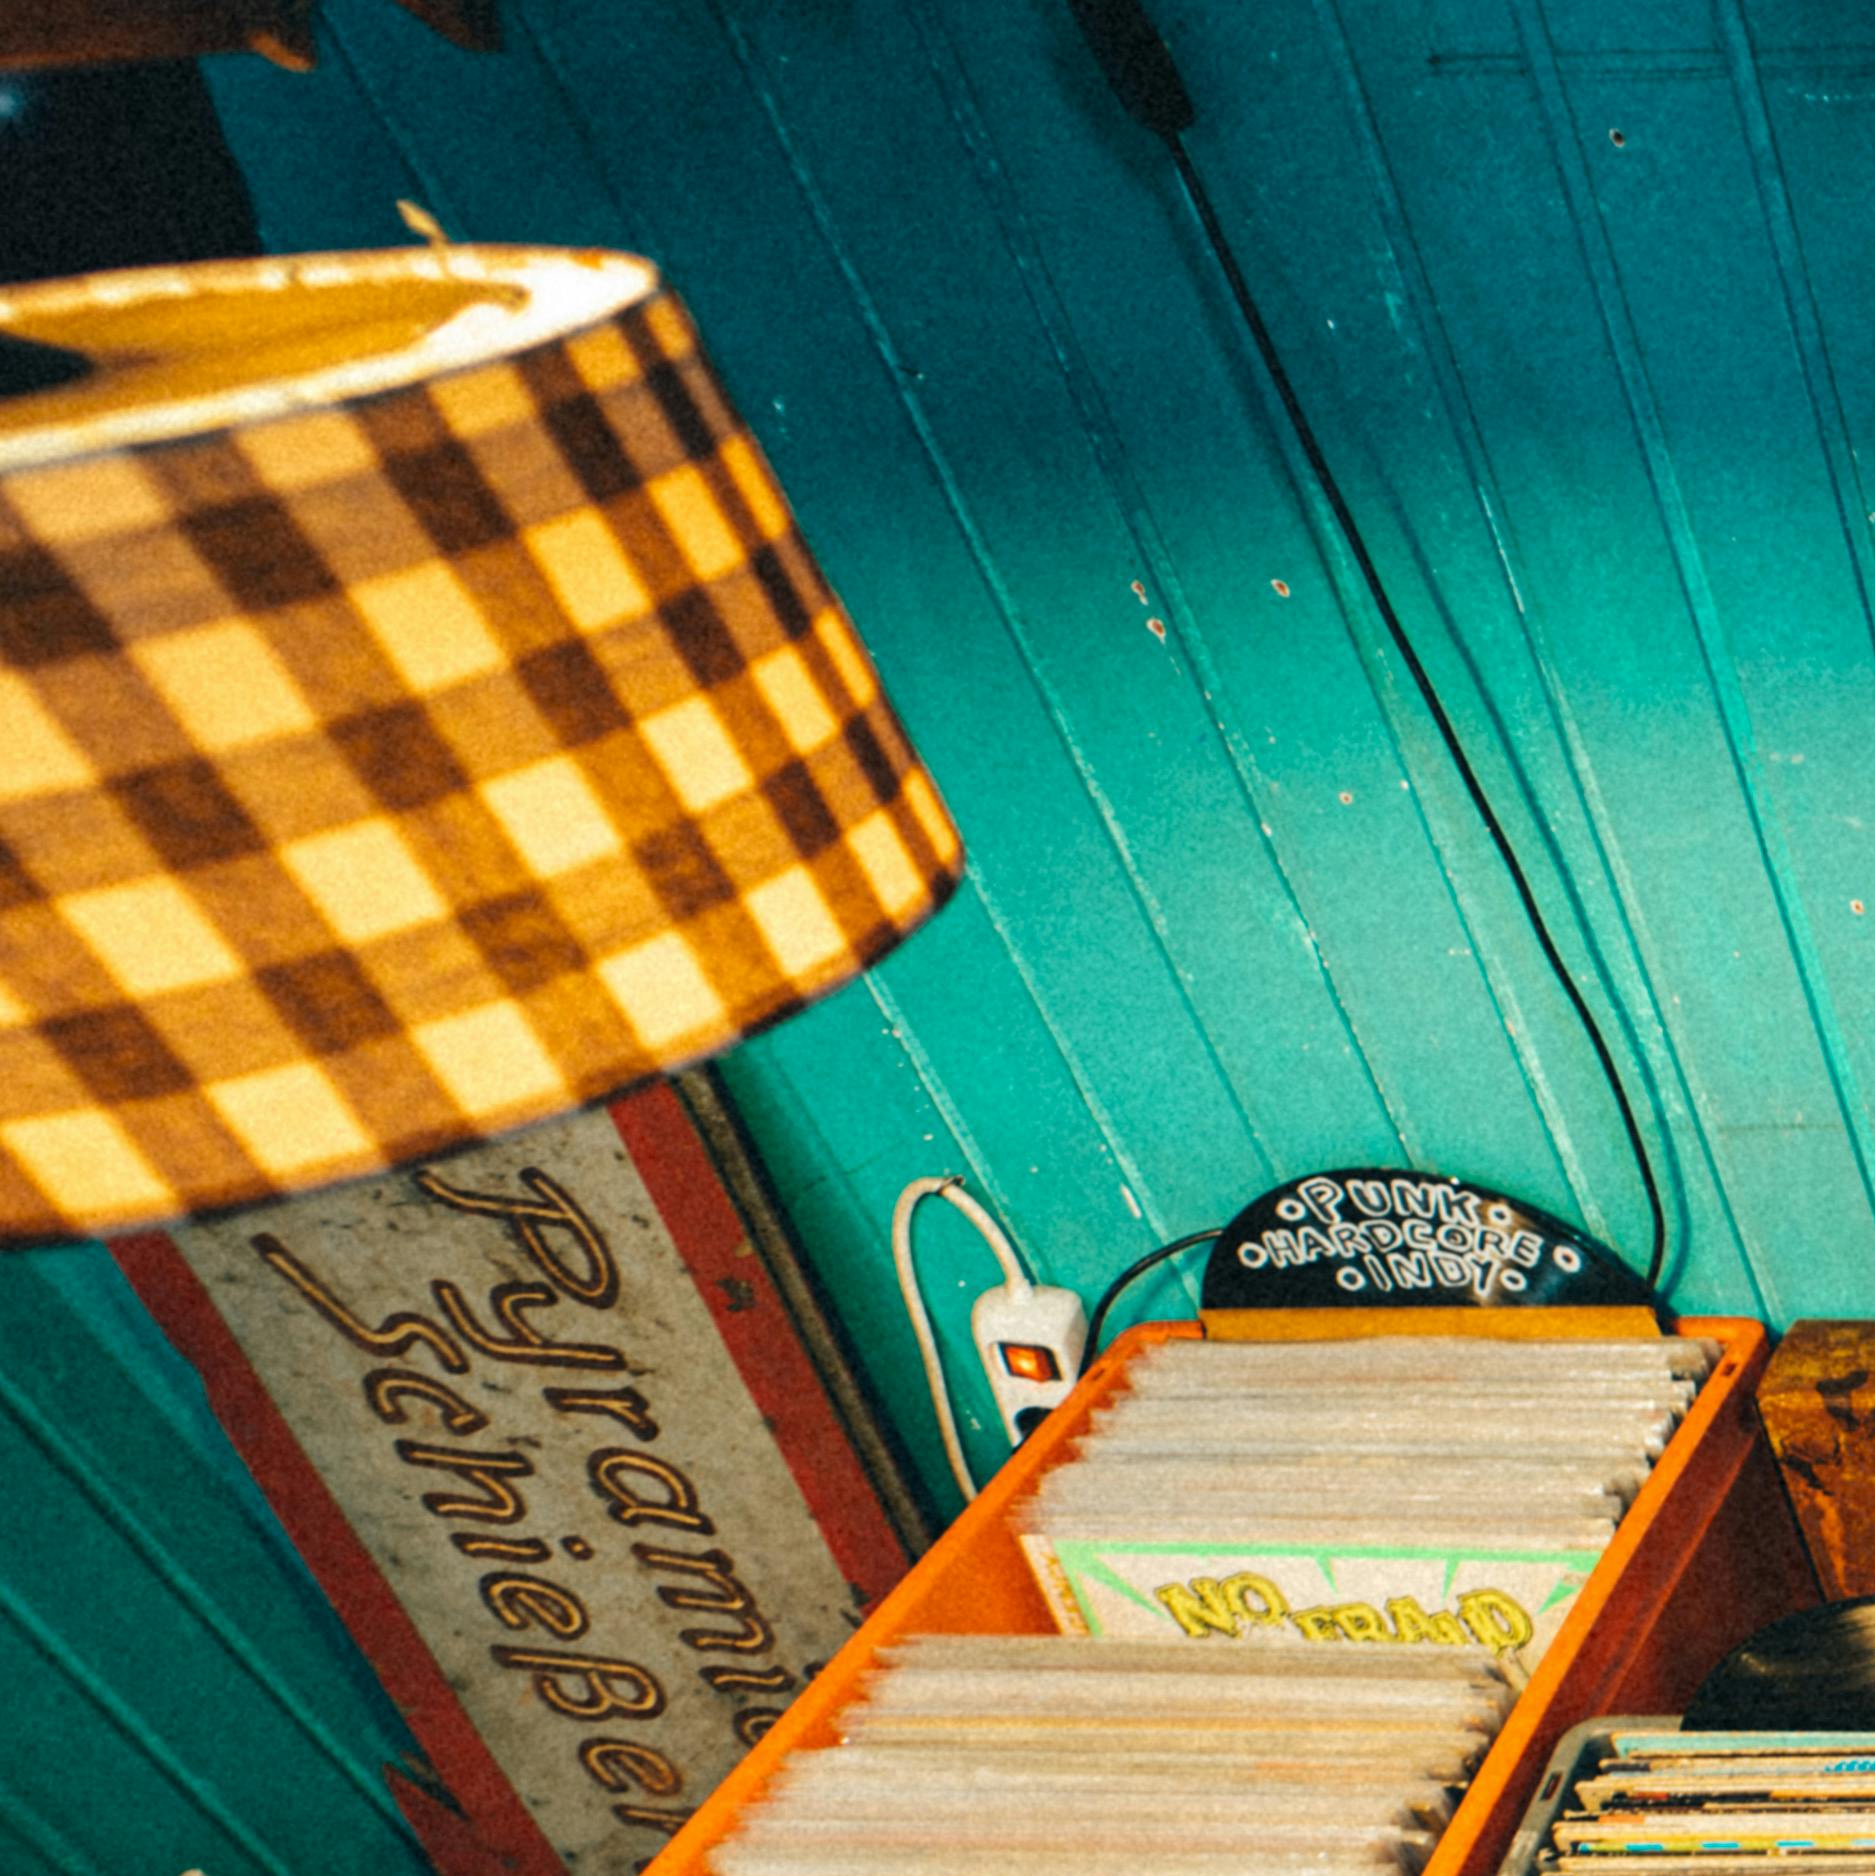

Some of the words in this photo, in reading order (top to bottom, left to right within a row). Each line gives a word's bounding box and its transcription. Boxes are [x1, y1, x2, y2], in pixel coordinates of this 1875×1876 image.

[1298, 1176, 1481, 1227] PUNK
[1262, 1219, 1543, 1268] HARDCORE
[1366, 1252, 1499, 1298] INDY
[1155, 1571, 1293, 1638] NO
